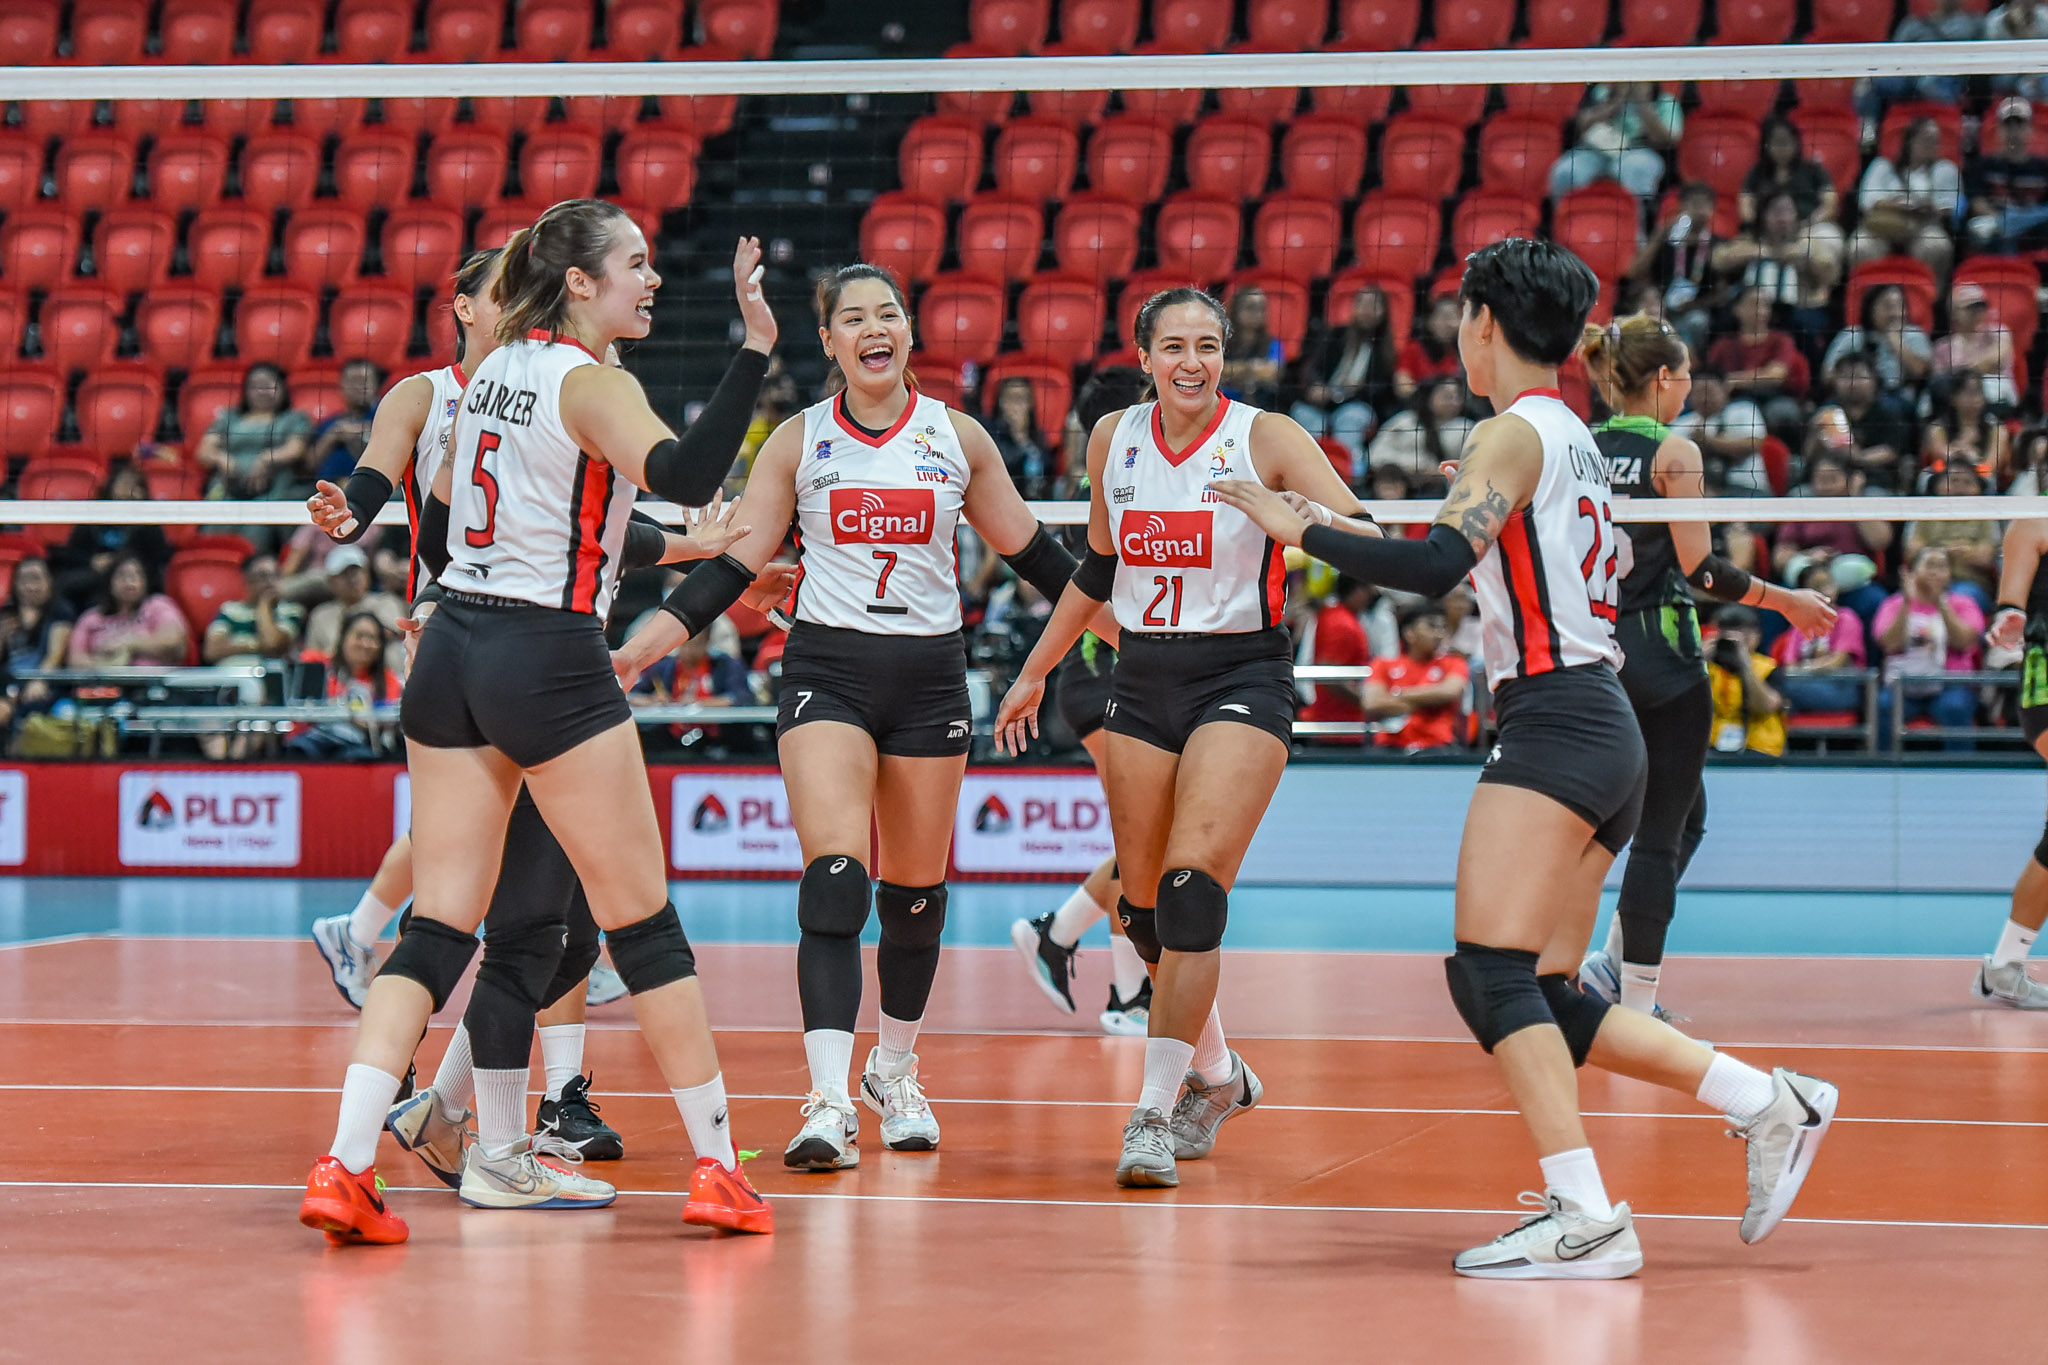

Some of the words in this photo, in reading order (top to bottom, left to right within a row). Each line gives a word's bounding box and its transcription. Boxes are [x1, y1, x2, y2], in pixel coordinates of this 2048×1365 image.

[465, 429, 502, 549] 5
[916, 471, 941, 482] LIVE
[1201, 491, 1222, 503] LIV
[836, 509, 927, 539] Cignal
[1123, 531, 1203, 563] Cignal
[871, 550, 898, 599] 7
[1142, 576, 1183, 626] 21
[794, 690, 813, 719] 7
[184, 795, 283, 826] PLDT
